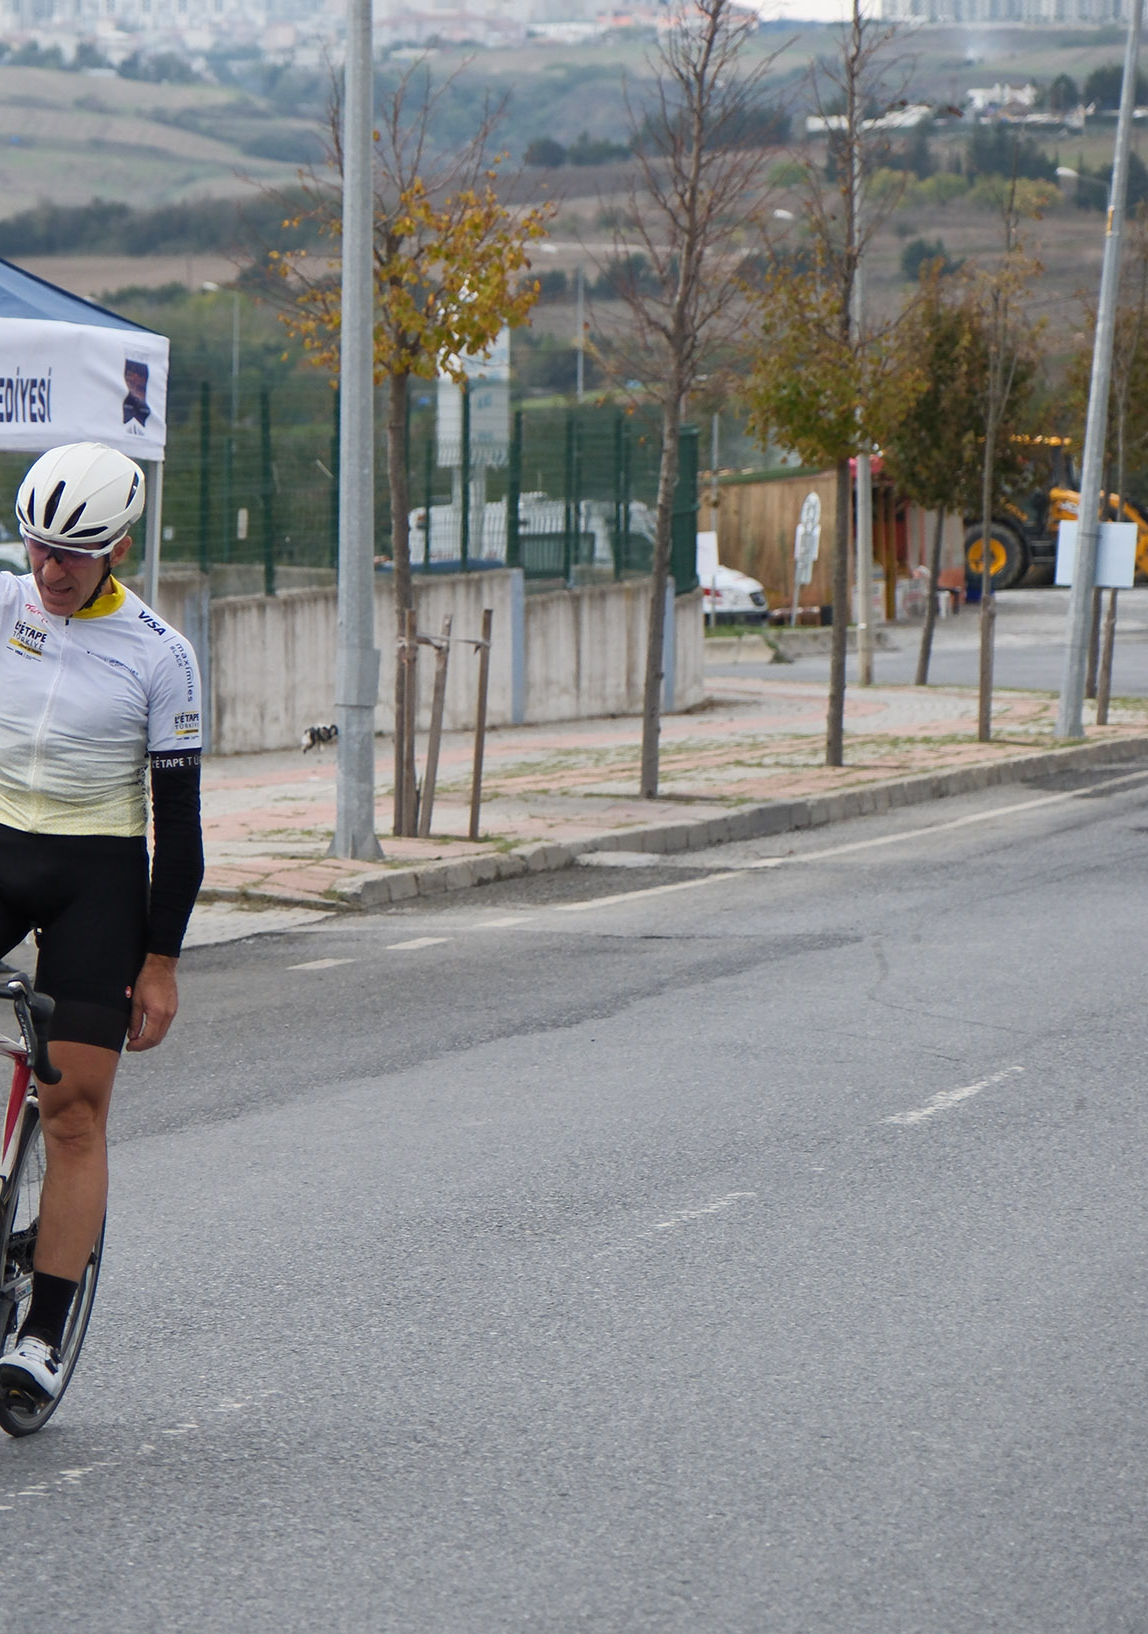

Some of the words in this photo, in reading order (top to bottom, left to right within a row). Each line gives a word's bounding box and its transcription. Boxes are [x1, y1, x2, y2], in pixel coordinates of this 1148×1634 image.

[138, 608, 167, 636] VISA
[169, 645, 184, 668] BLACK
[175, 643, 195, 703] maximiles
